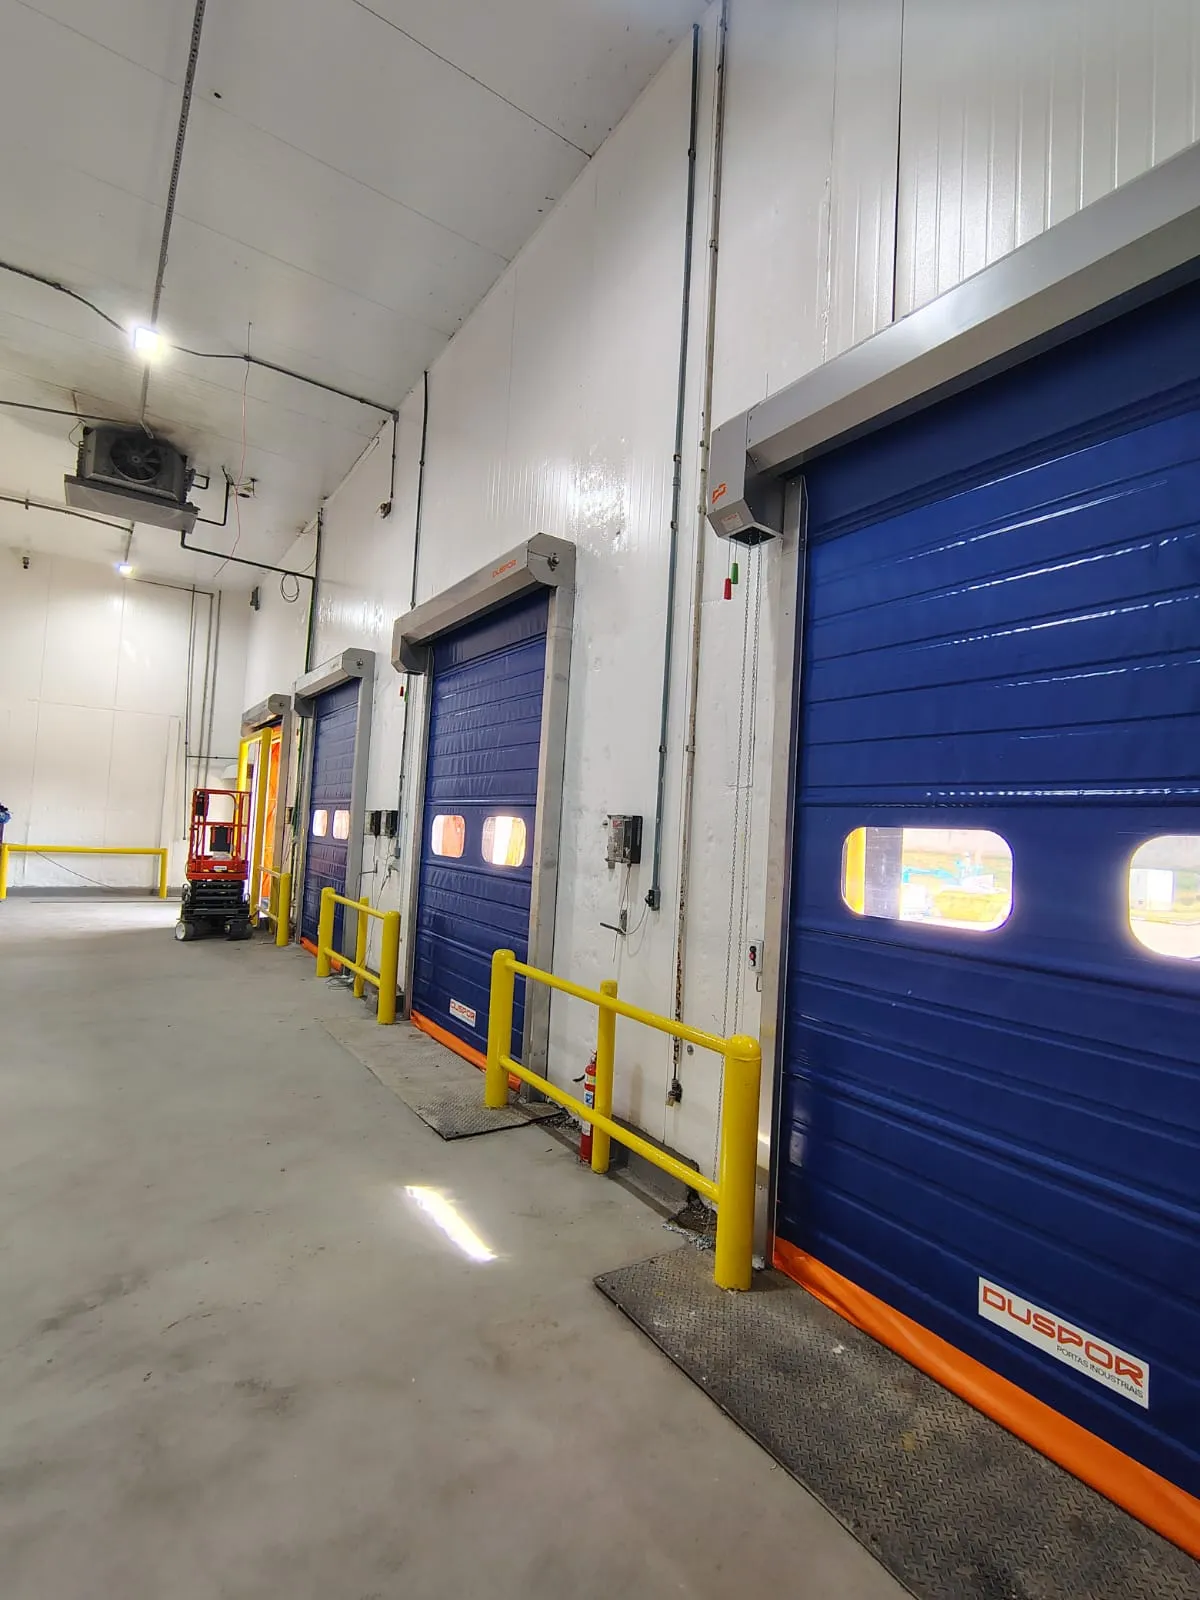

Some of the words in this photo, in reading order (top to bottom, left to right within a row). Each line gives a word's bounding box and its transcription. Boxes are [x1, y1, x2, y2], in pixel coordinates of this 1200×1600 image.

[451, 1001, 475, 1020] DUSPOR
[983, 1286, 1144, 1388] DUSPOR
[1056, 1345, 1088, 1368] PORTAS
[1089, 1363, 1144, 1399] INDUSTRIAIS
